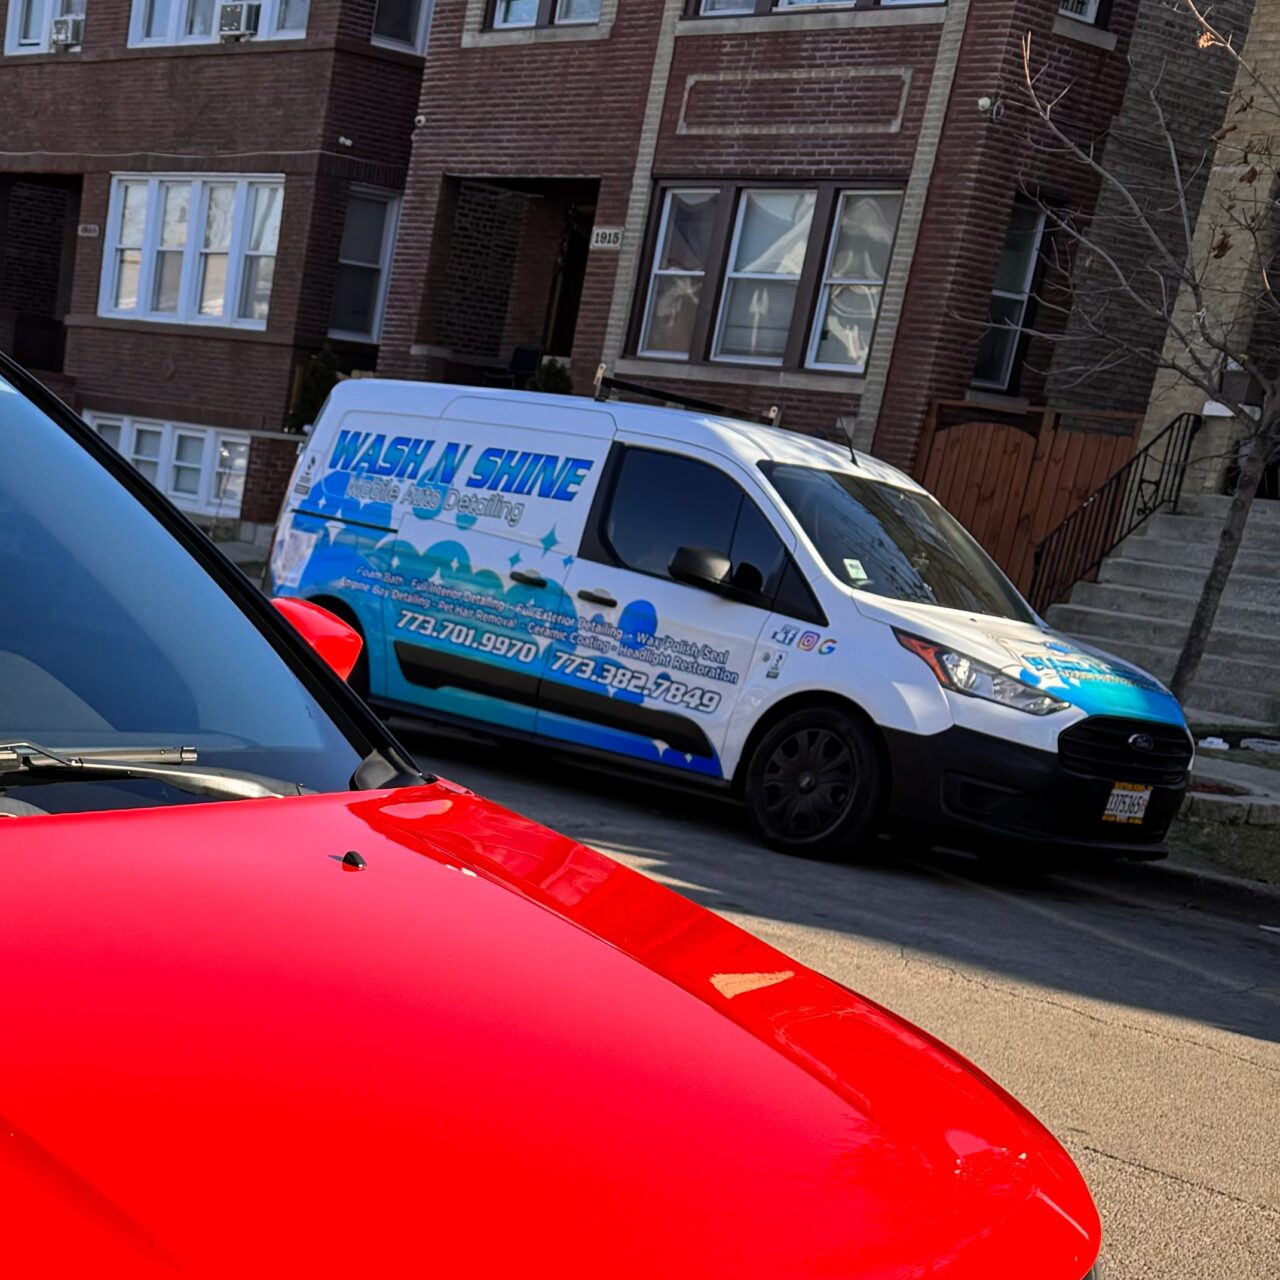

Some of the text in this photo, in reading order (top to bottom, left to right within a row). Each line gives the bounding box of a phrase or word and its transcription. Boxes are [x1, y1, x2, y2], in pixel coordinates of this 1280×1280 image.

[594, 231, 620, 245] 1915
[328, 430, 594, 502] WASH N SHINE
[346, 476, 526, 527] Mobile Auto Detailing
[391, 588, 431, 609] Detailing
[475, 609, 517, 628] Removal
[526, 621, 567, 642] Ceramic
[569, 633, 611, 654] Coating
[619, 644, 671, 669] Headlight
[671, 657, 739, 685] Restoration
[463, 590, 505, 612] Detailing
[535, 605, 577, 627] Exterior
[578, 617, 624, 641] Detailing
[395, 609, 722, 714] 773.701.9970 773.382.7849
